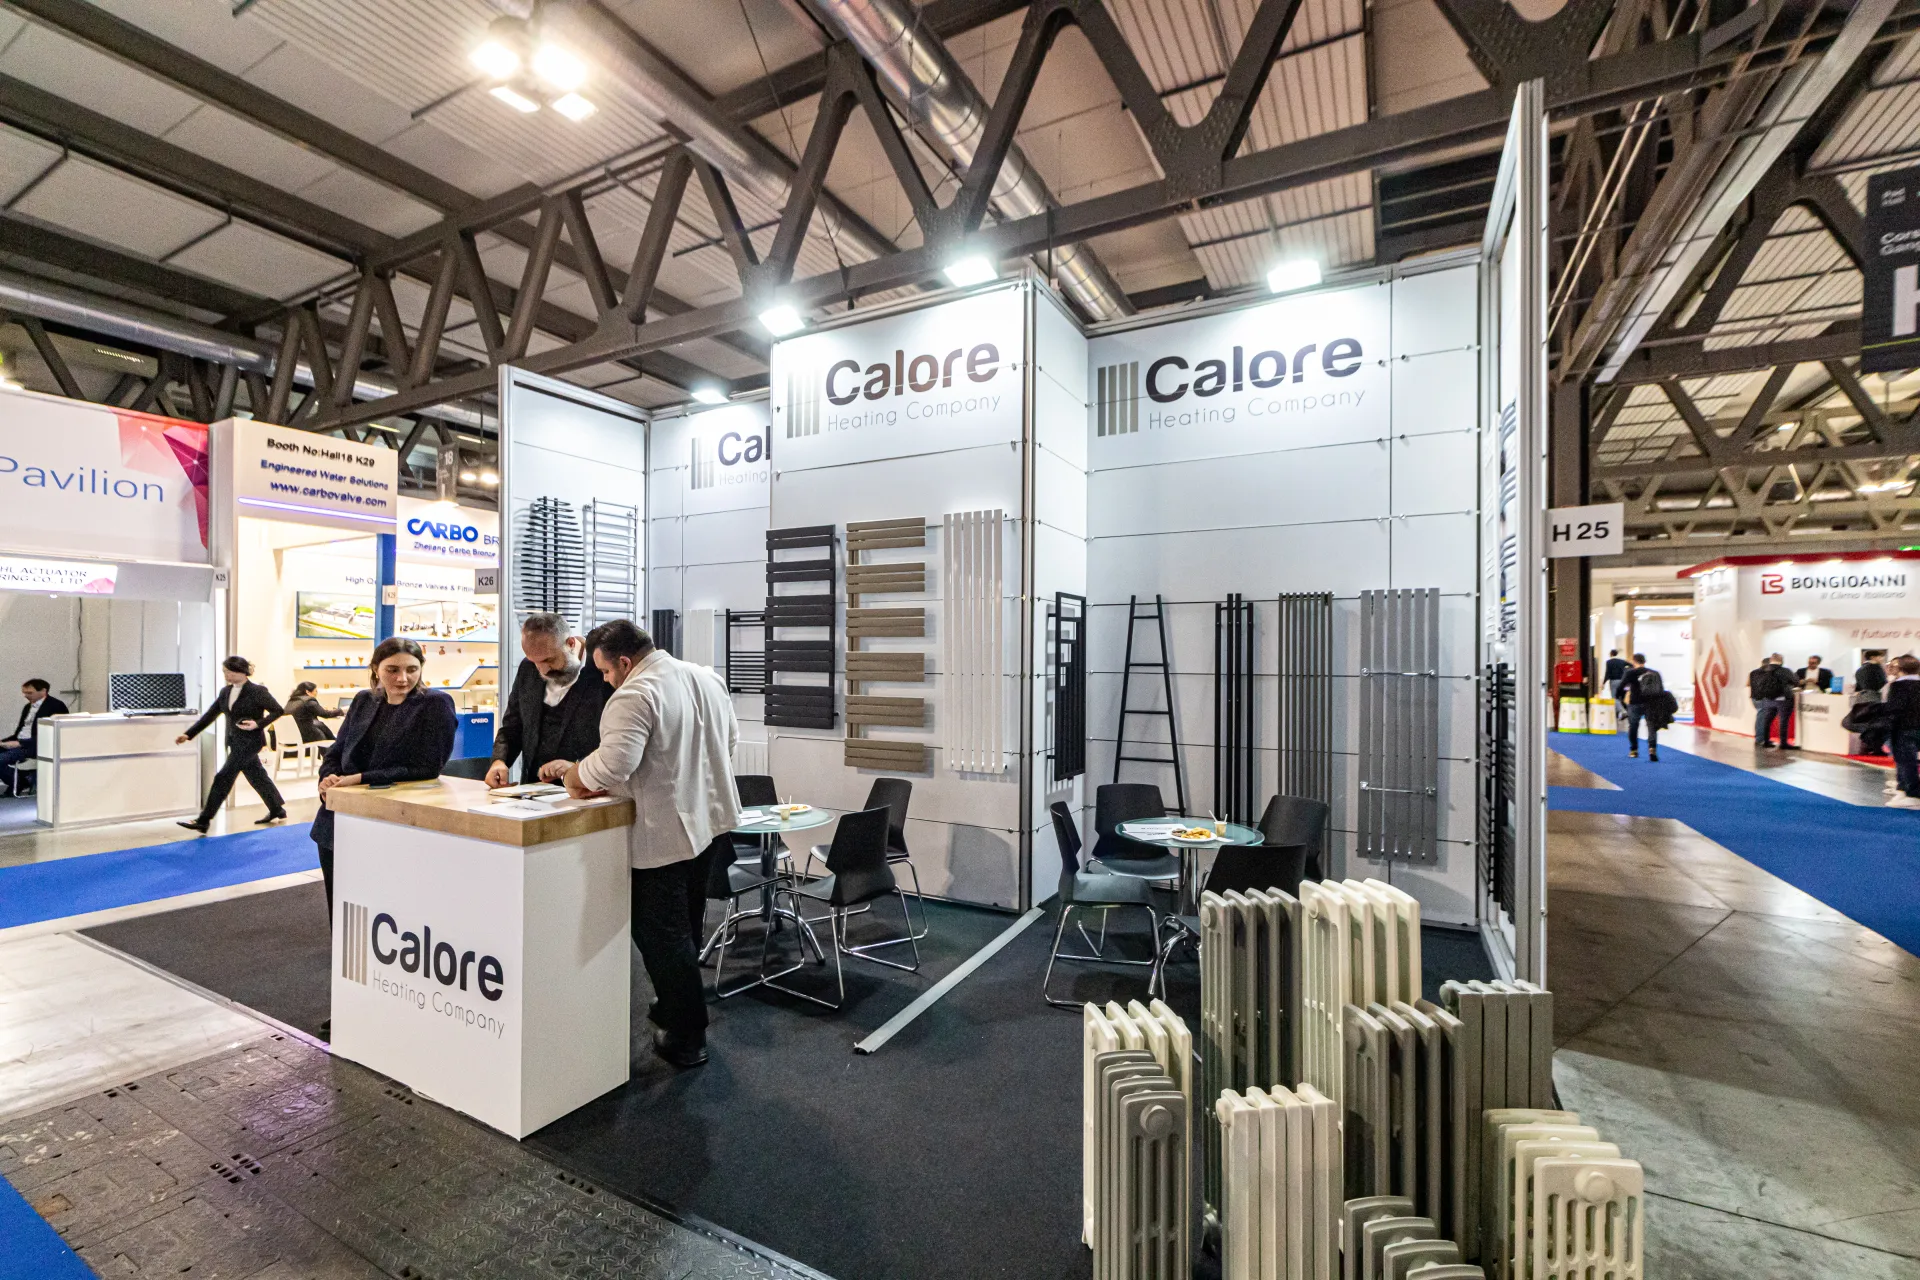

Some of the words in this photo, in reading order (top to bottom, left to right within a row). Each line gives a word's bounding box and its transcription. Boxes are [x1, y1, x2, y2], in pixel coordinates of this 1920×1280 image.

[825, 342, 1000, 406] Calore
[1145, 337, 1363, 404] Calore
[827, 410, 897, 432] Heating
[906, 395, 1001, 420] Company
[1149, 406, 1236, 430] Heating
[1247, 389, 1366, 417] Company
[267, 438, 300, 453] Booth
[355, 455, 375, 468] K29
[444, 450, 454, 465] 18
[717, 425, 771, 467] Cal
[0, 456, 164, 502] Pavilion
[260, 459, 318, 478] Engineered
[319, 470, 347, 483] Water
[349, 476, 389, 491] Solutions
[719, 470, 769, 486] Heating
[270, 481, 388, 508] www.carbovalve.com
[407, 518, 479, 543] CARBO
[1552, 523, 1571, 542] H
[1576, 521, 1609, 540] 25
[448, 546, 471, 555] Carbo
[472, 548, 496, 557] Bronze
[21, 567, 87, 578] ACTUATOR
[345, 576, 365, 585] High
[396, 579, 423, 589] Bronze
[424, 582, 448, 591] Valves
[478, 576, 494, 587] K26
[1791, 574, 1906, 590] BONGIOANNI
[371, 912, 504, 1002] Calore
[372, 970, 426, 1010] Heating
[431, 991, 505, 1040] Company
